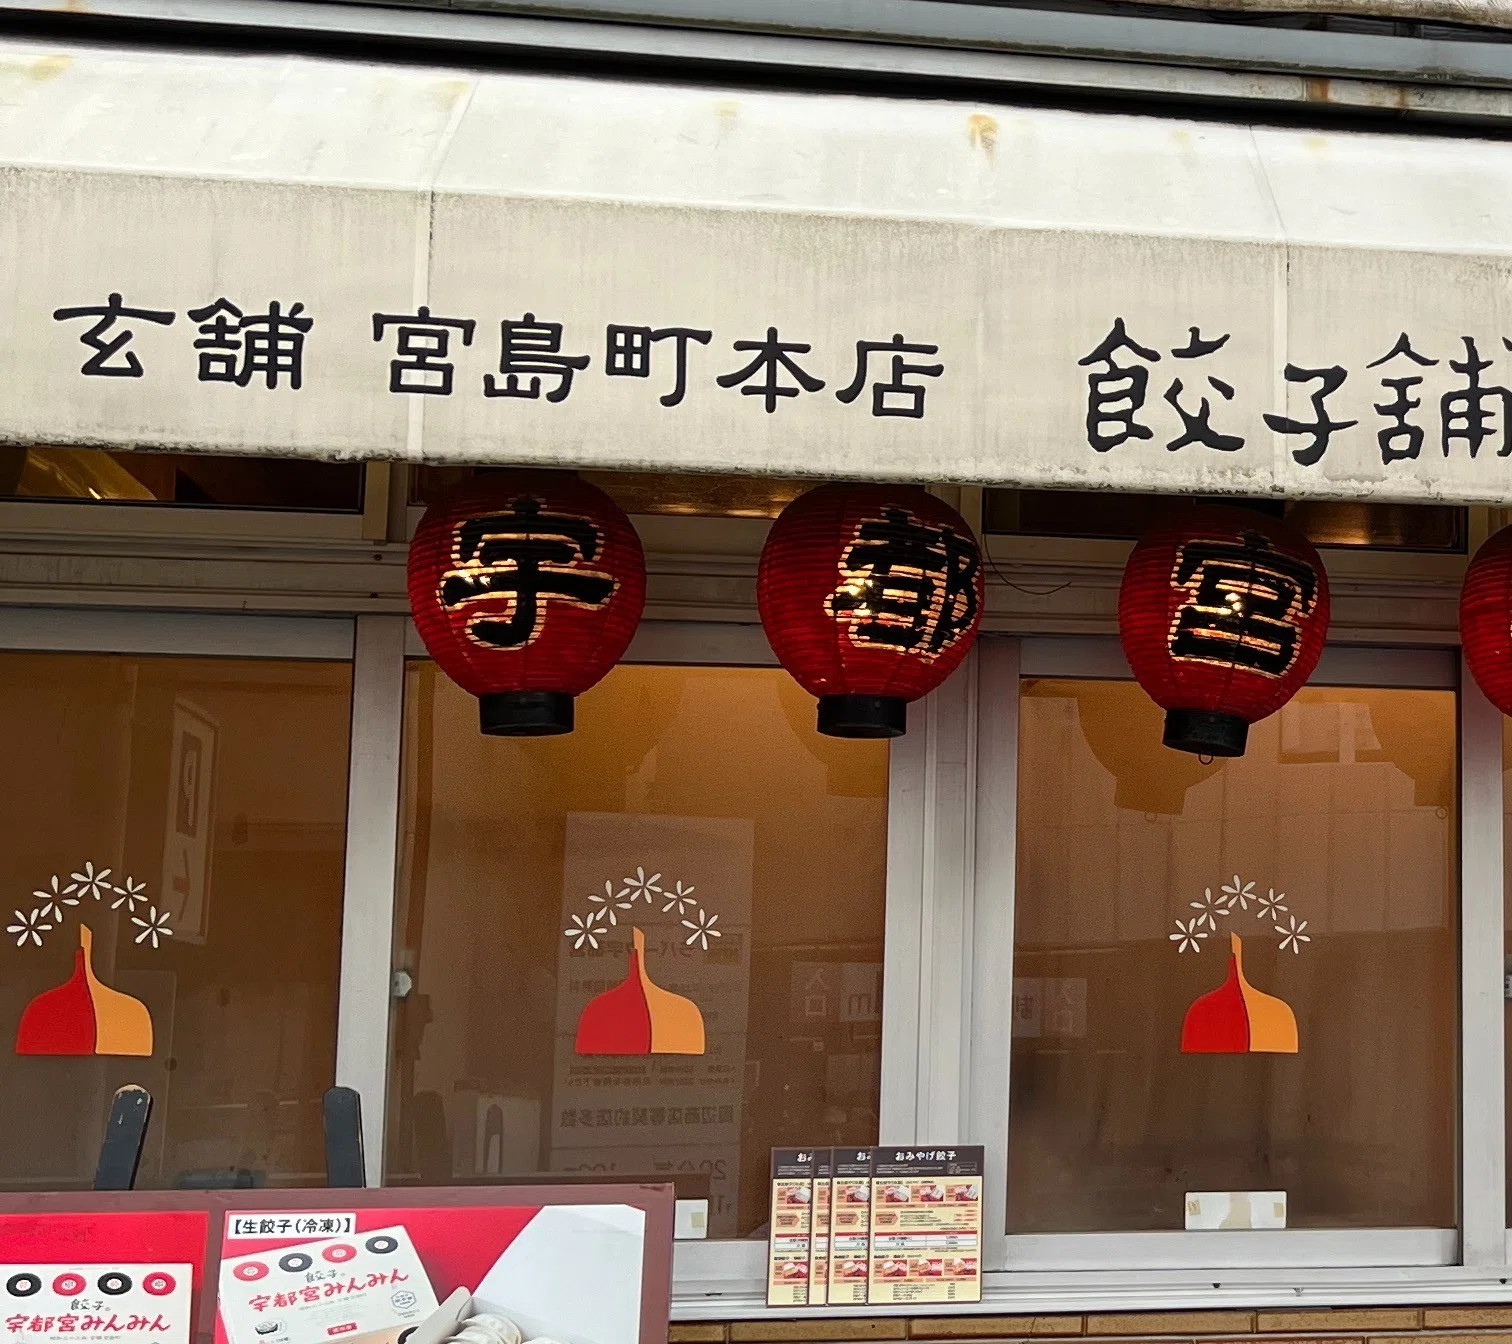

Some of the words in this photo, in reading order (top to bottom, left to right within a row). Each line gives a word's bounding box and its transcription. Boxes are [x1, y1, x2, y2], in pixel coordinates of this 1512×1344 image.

[53, 292, 315, 389] 玄舗
[372, 305, 946, 420] 宮島町本店
[441, 496, 622, 651] 宇
[824, 504, 984, 663] 都
[1168, 529, 1319, 679] 宮
[4, 1312, 172, 1333] 宇都宮みんみん
[248, 1267, 410, 1312] 宇都宮みんみん
